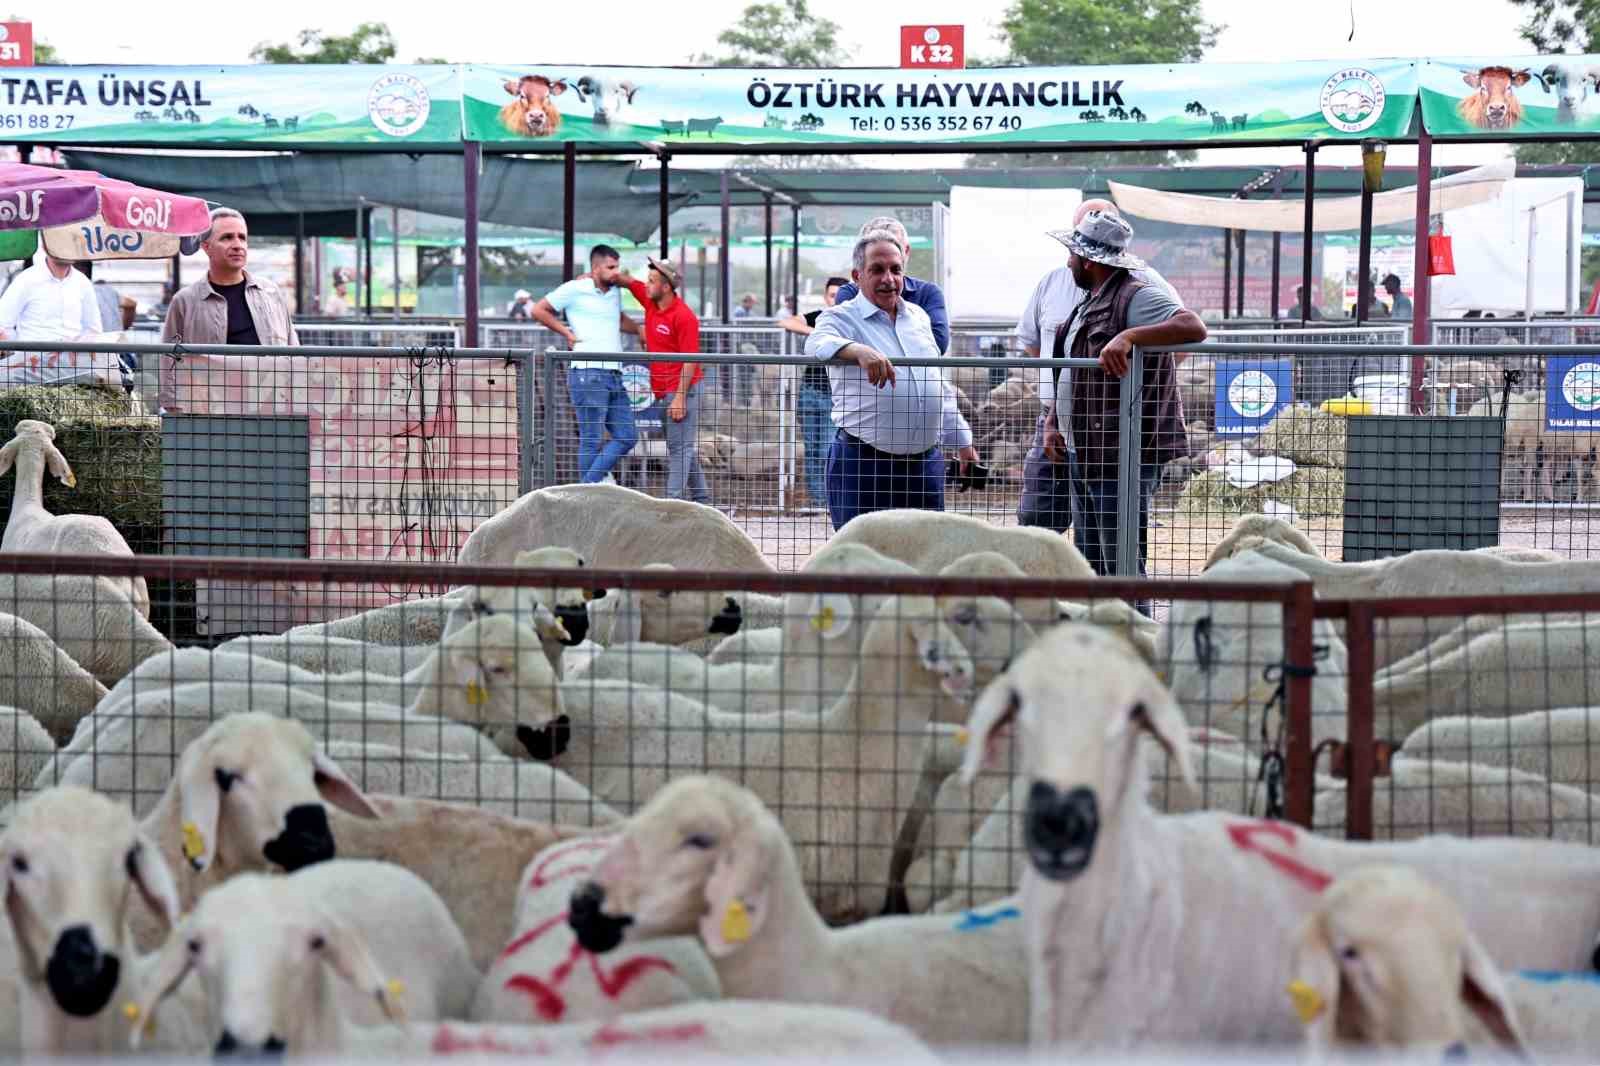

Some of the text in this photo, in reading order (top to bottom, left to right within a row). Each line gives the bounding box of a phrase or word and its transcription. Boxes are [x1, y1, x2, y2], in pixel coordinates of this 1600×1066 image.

[910, 44, 954, 63] K 32
[98, 73, 212, 107] ÜNSAL
[747, 78, 1125, 108] ÖZTÜRK HAYVANCILIK
[28, 114, 50, 129] 88
[55, 114, 75, 129] 27
[850, 115, 1022, 131] Tel: 0 536 352 67 40
[126, 196, 173, 229] Golf
